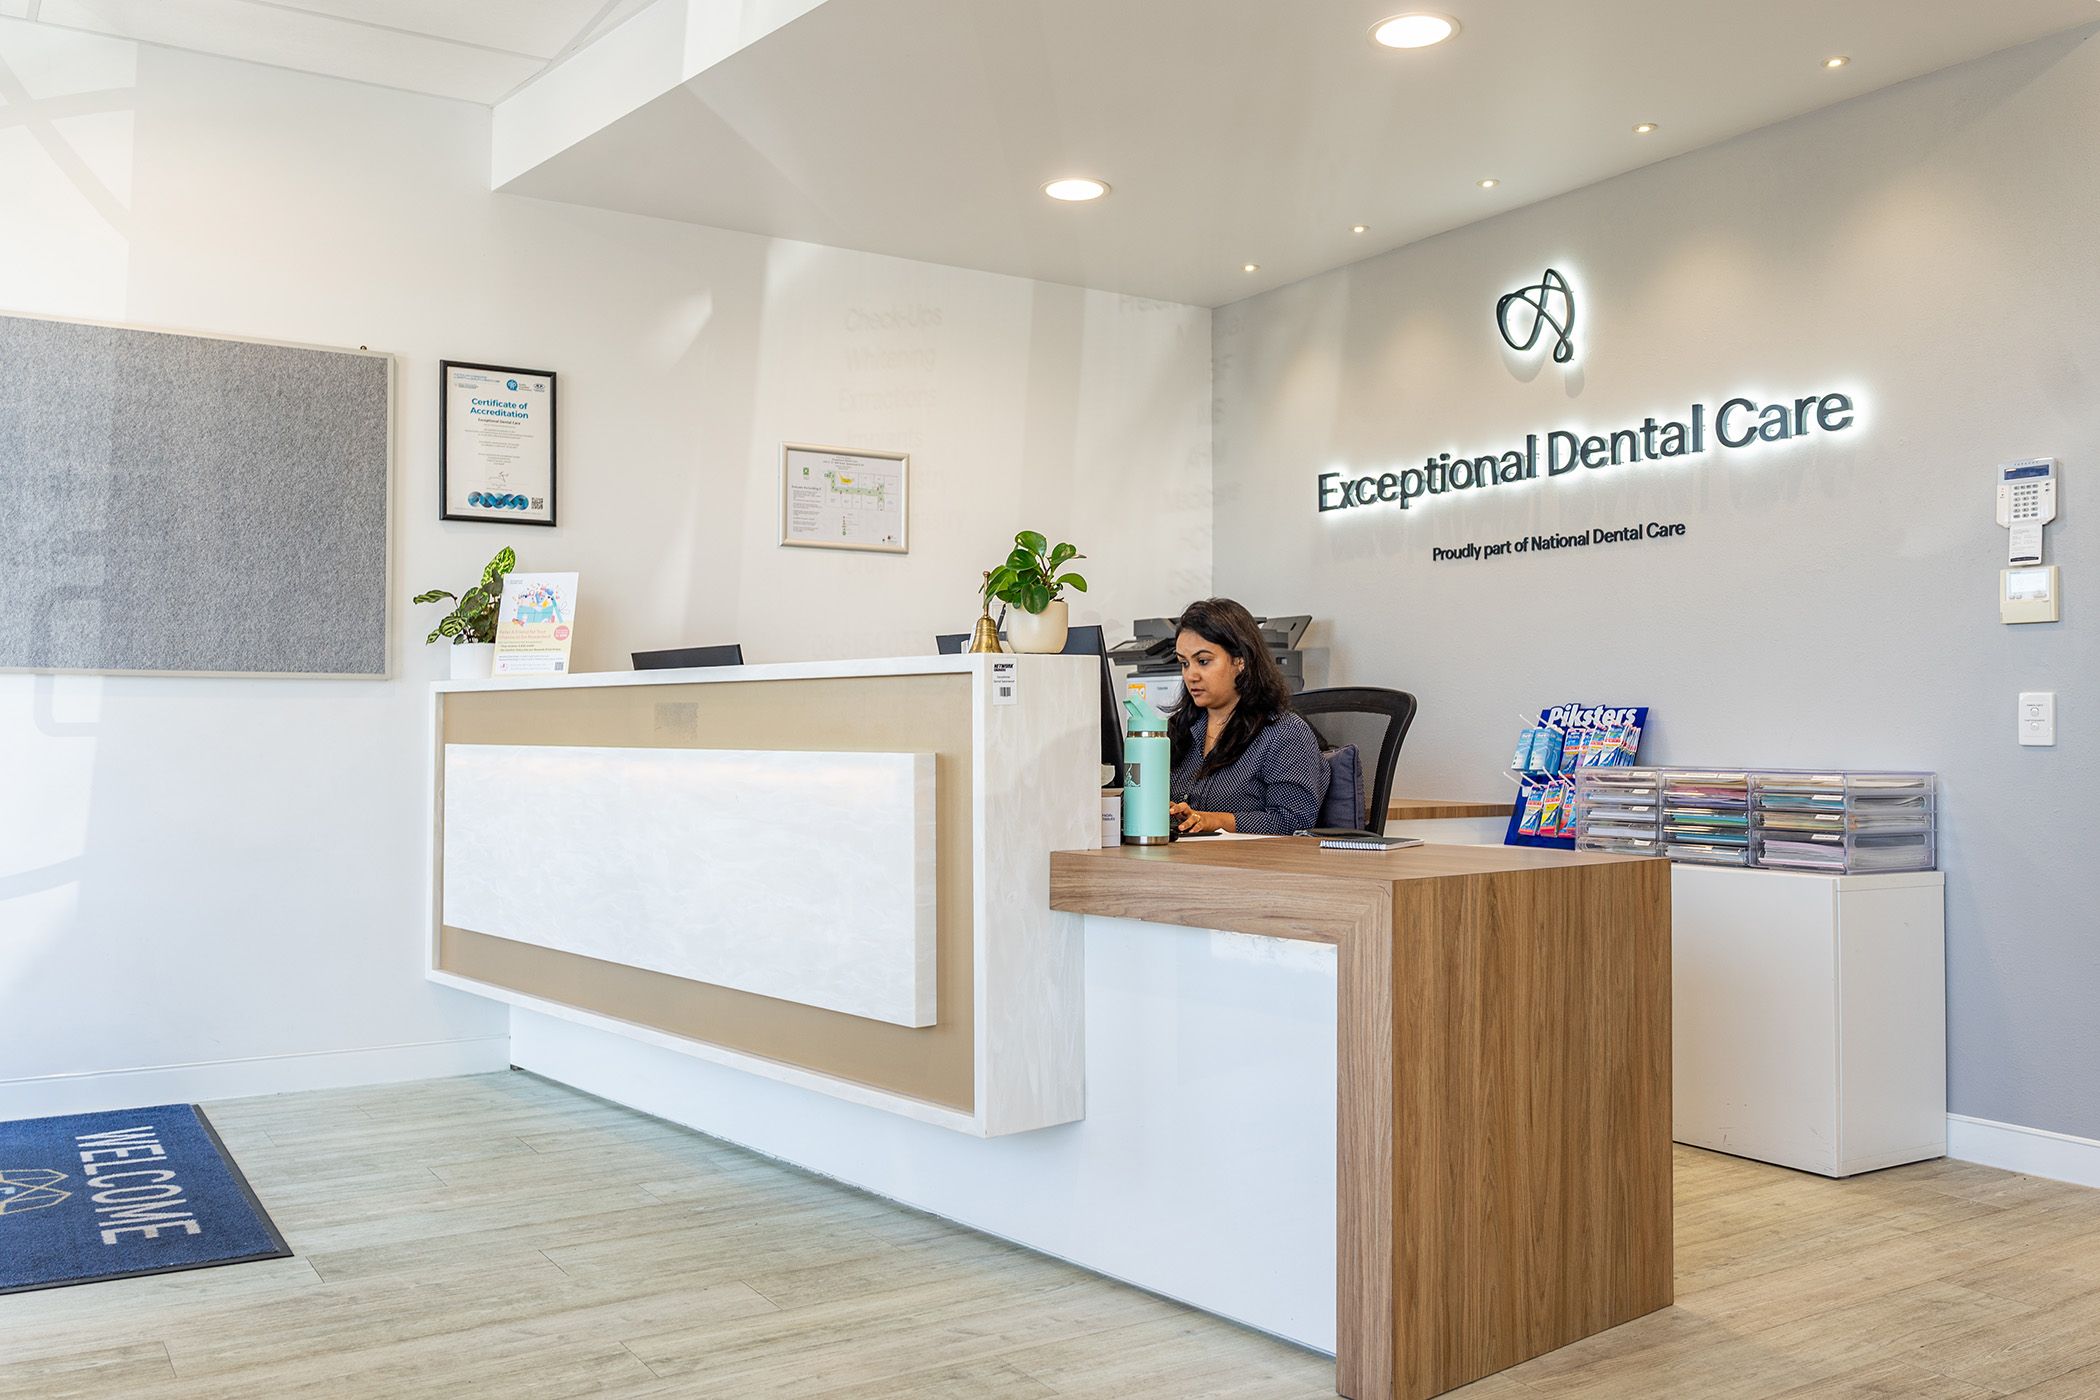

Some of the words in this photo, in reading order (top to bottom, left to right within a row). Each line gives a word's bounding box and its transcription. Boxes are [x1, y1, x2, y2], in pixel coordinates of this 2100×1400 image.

[470, 407, 529, 419] Accreditation
[471, 397, 517, 409] Certificate
[519, 402, 528, 410] of
[1317, 434, 1536, 512] Exceptional
[1547, 403, 1704, 477] Dental
[1715, 392, 1854, 448] Care
[1433, 543, 1481, 561] Proudly
[1484, 541, 1512, 559] part
[1514, 537, 1529, 552] of
[1531, 530, 1590, 551] National
[1593, 524, 1643, 544] Dental
[1646, 522, 1686, 539] Care
[1550, 704, 1638, 728] Piksters
[75, 1126, 202, 1246] WELCOME
